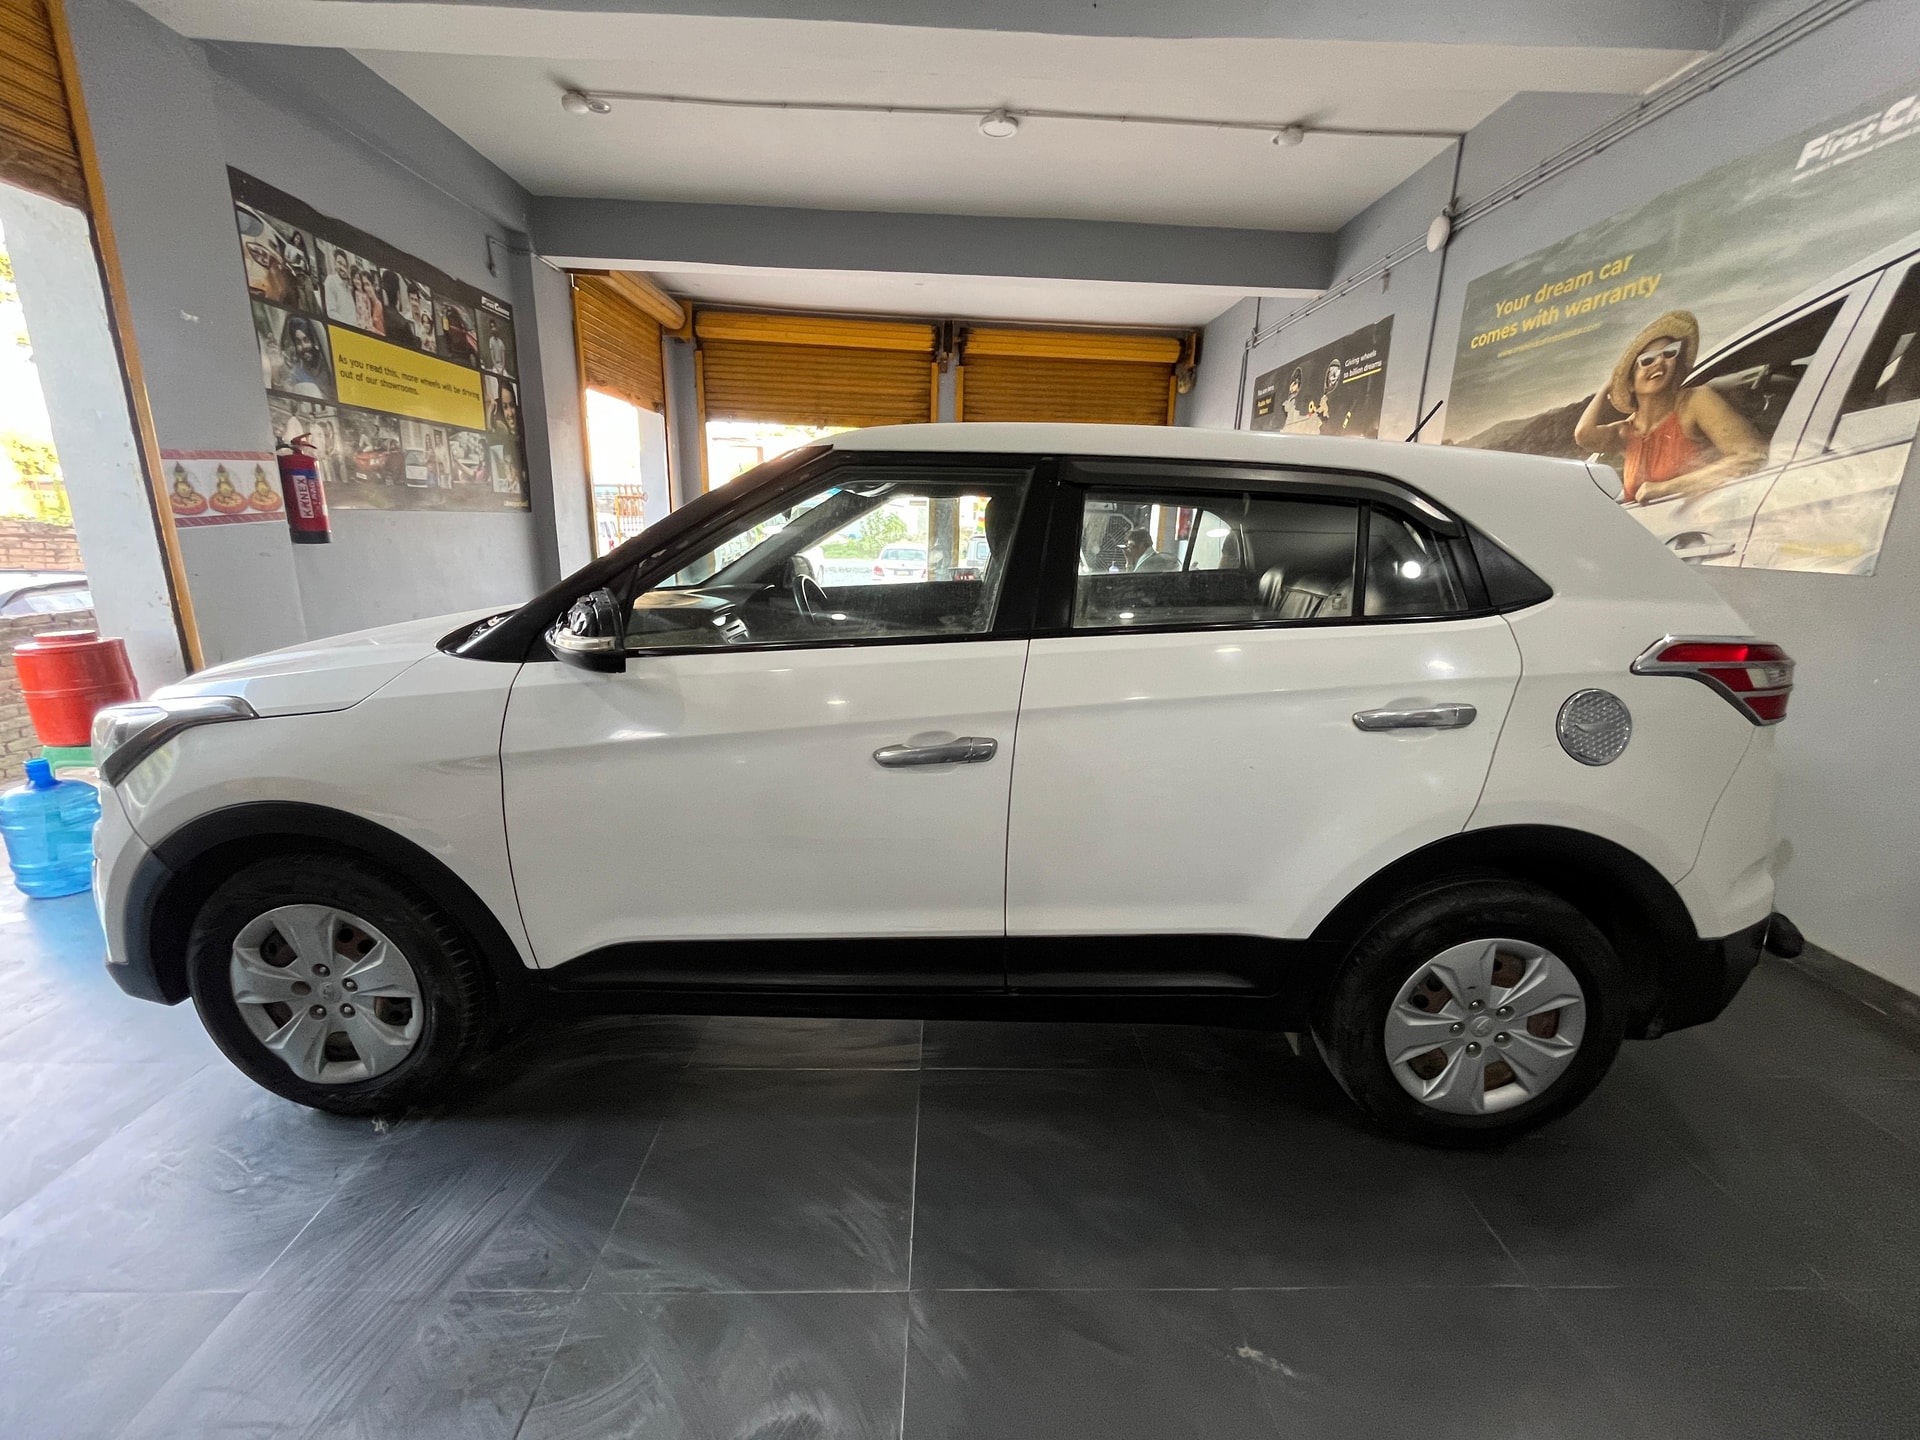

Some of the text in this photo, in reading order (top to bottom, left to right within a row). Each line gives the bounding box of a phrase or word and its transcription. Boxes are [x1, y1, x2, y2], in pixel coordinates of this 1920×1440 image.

[1496, 254, 1634, 318] Your dream car
[1471, 322, 1518, 349] comes
[1522, 306, 1560, 332] with
[1565, 273, 1662, 318] warranty
[338, 354, 348, 365] As
[350, 358, 364, 369] you
[365, 363, 382, 374] read
[401, 373, 418, 384] more
[339, 369, 354, 380] out
[355, 372, 363, 382] of
[365, 375, 378, 385] our
[1345, 357, 1360, 367] Giving
